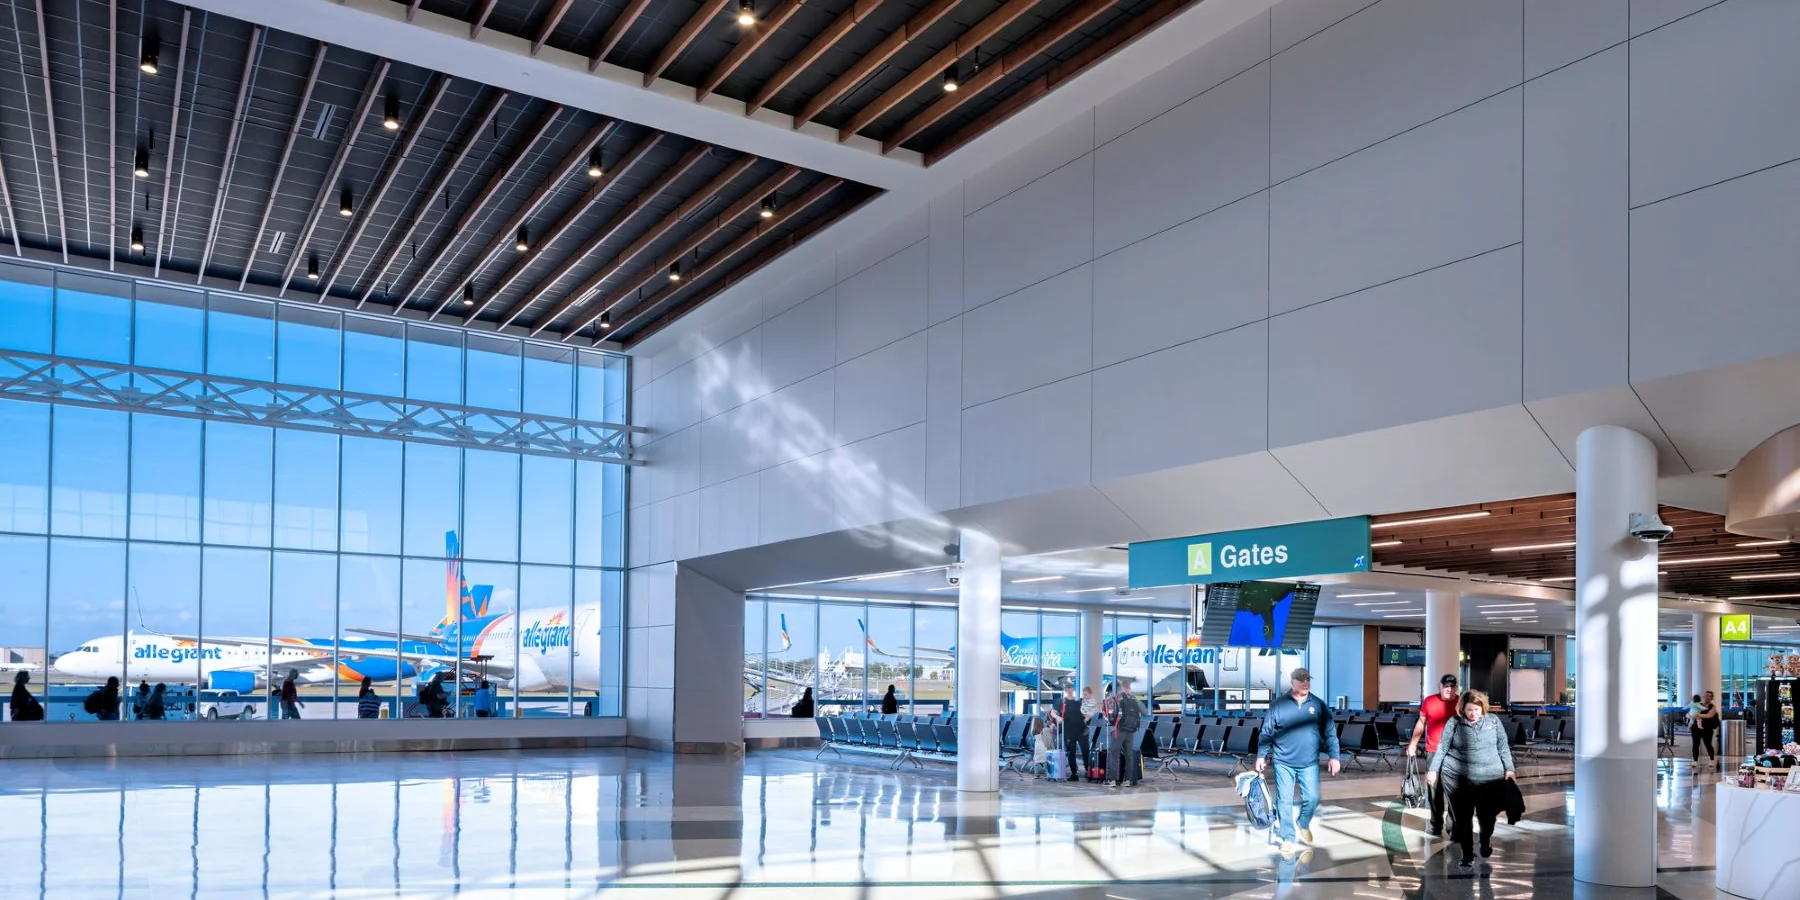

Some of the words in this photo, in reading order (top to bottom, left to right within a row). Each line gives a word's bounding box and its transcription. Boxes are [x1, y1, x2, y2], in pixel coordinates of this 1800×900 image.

[1192, 549, 1207, 570] A
[1220, 543, 1288, 568] Gates
[1723, 620, 1747, 635] A4
[134, 644, 222, 664] allegiant
